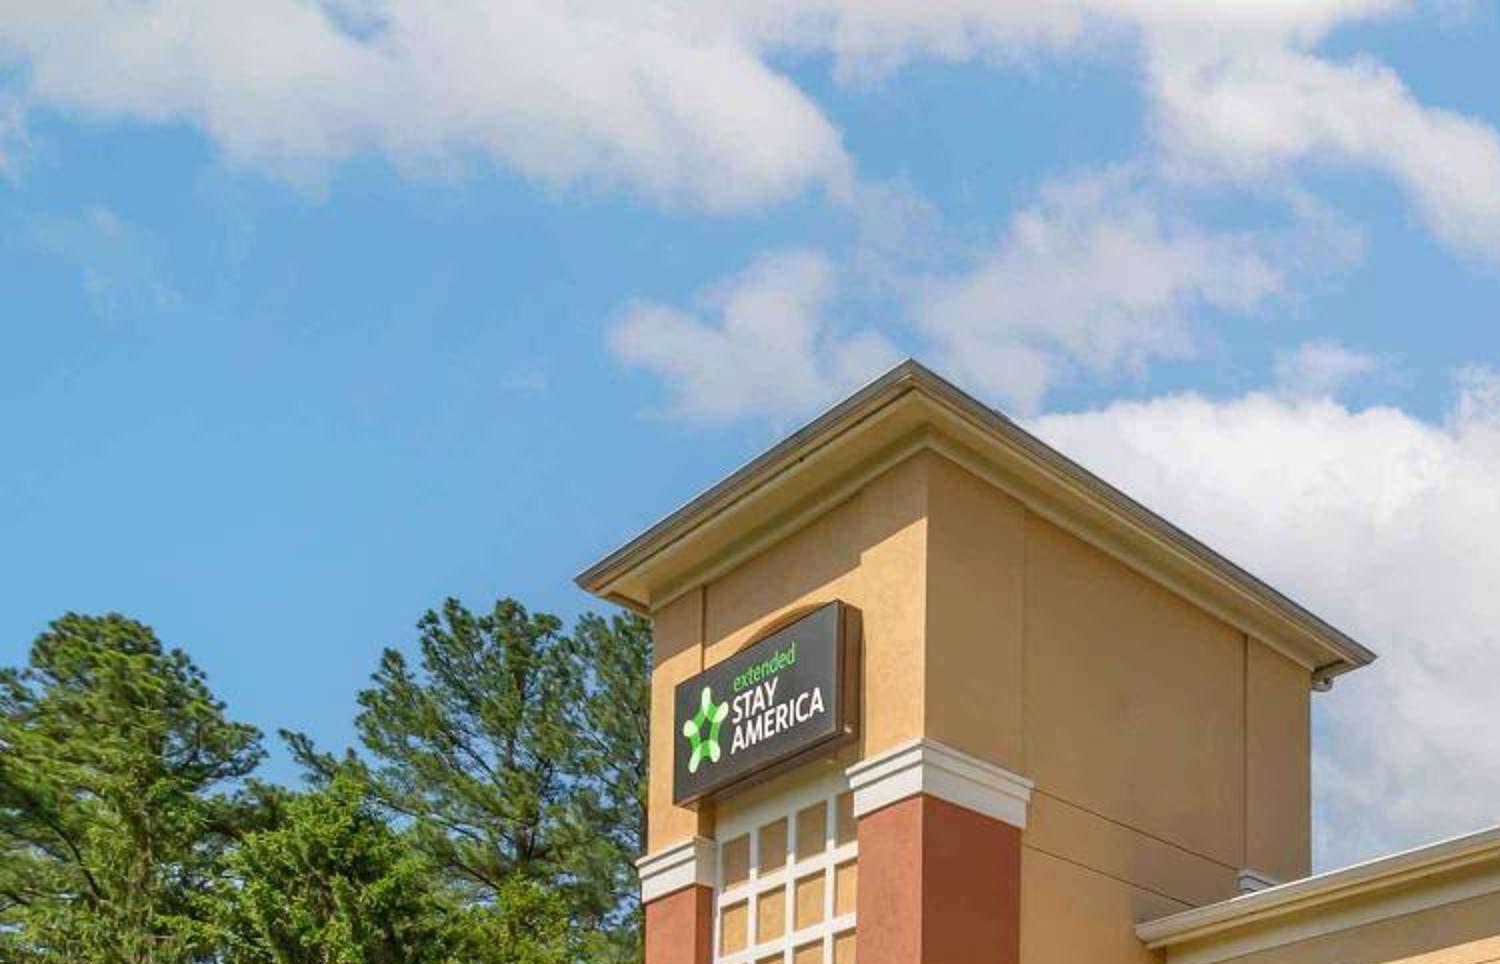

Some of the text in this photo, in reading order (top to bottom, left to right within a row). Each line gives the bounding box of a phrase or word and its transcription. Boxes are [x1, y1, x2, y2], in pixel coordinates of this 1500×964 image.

[733, 642, 797, 691] extended
[731, 687, 825, 754] AMERICA
[732, 677, 778, 723] STAY
